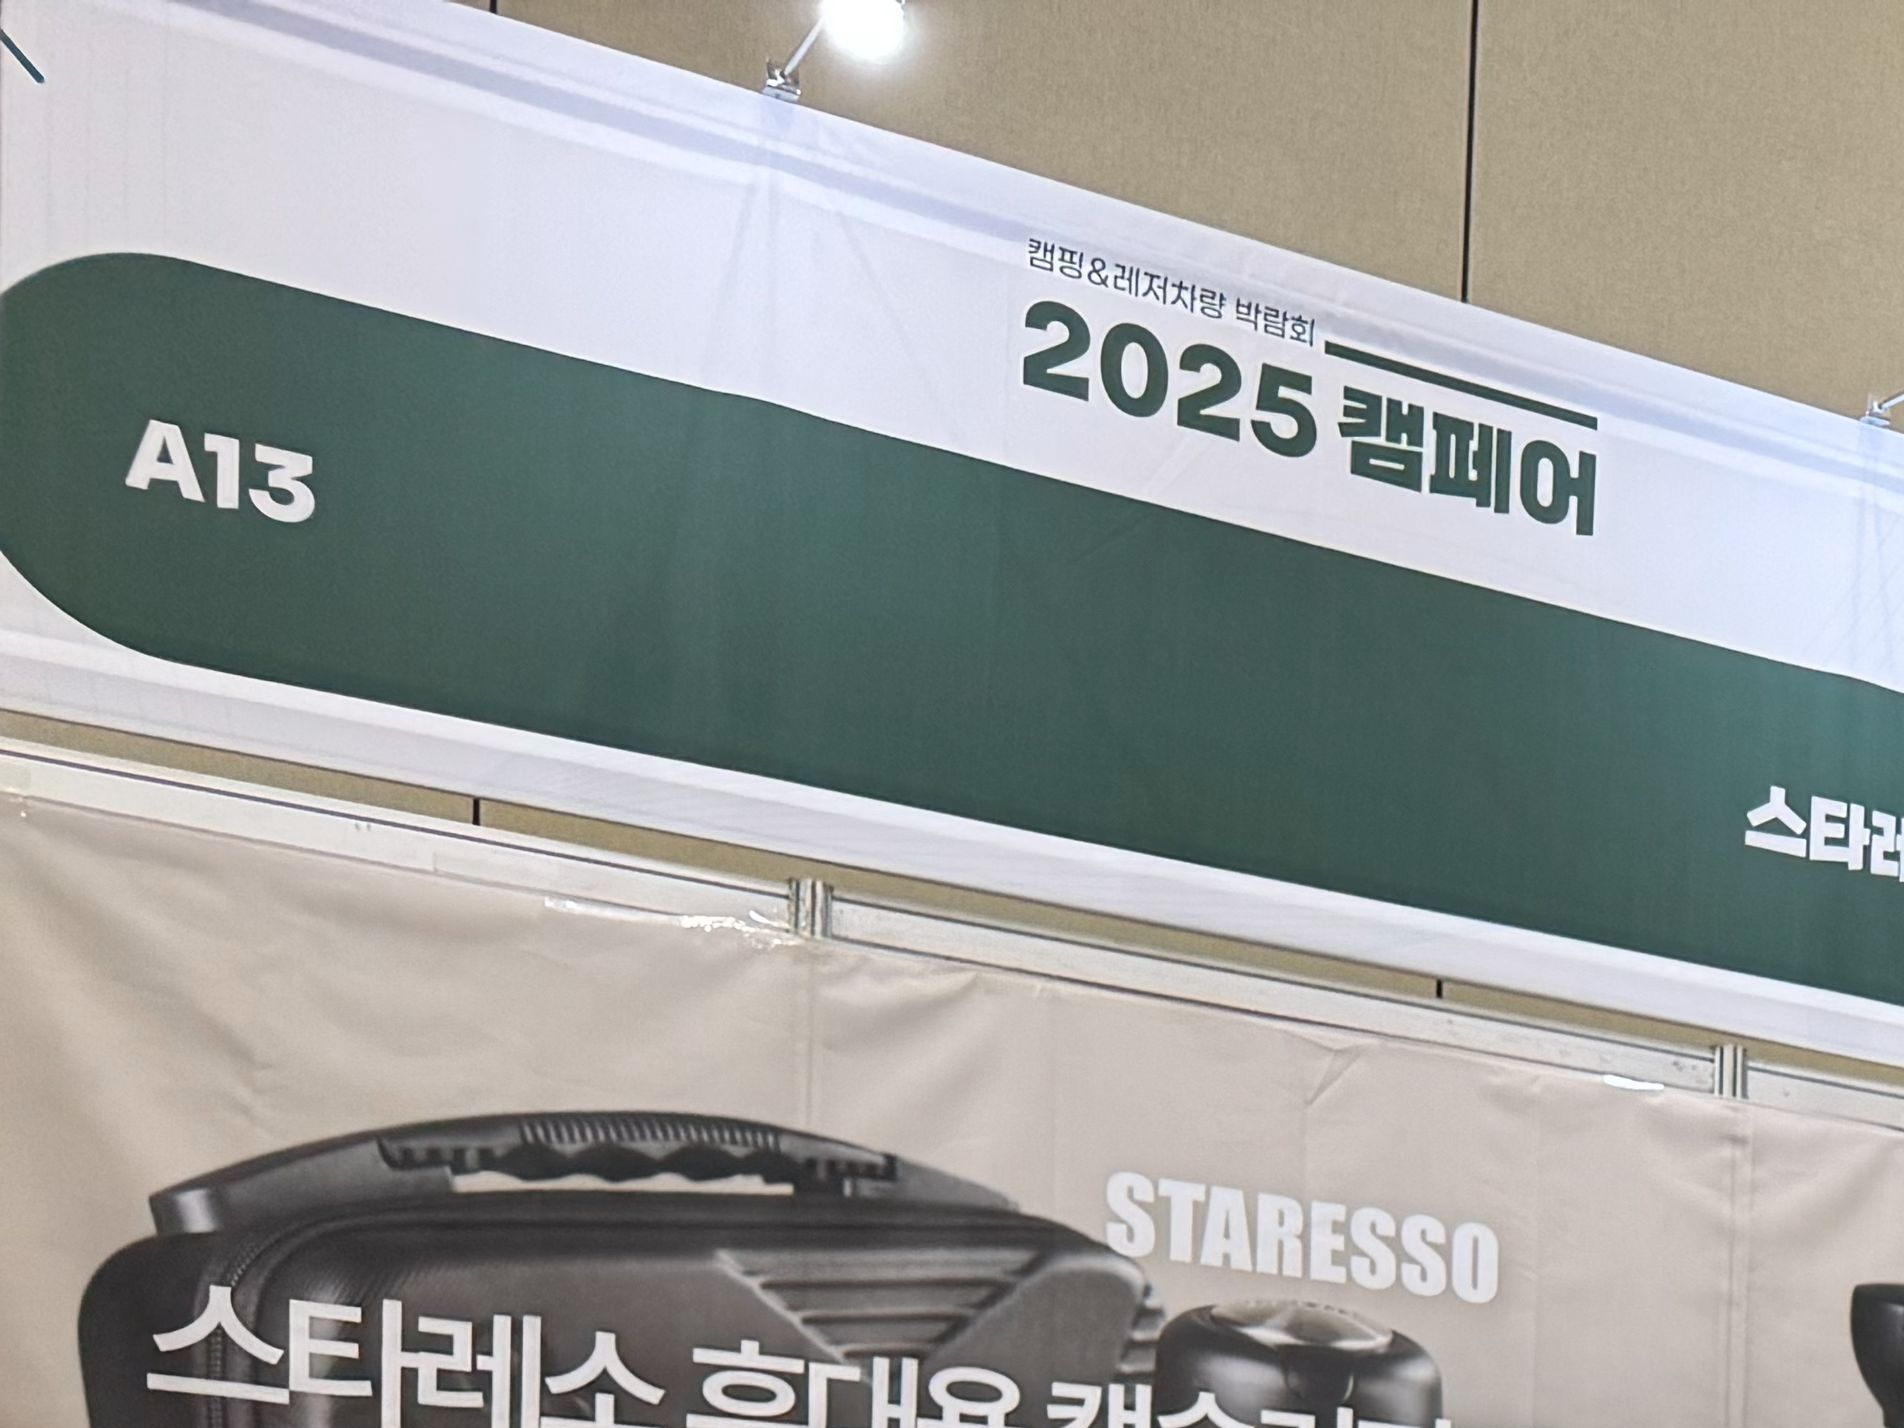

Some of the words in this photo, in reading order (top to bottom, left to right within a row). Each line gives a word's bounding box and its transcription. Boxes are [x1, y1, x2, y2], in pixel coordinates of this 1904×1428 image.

[1028, 238, 1227, 319] 캠핑&레저차량
[1235, 297, 1315, 347] 박람회
[124, 418, 317, 524] A13
[1023, 301, 1319, 459] 2025
[1337, 384, 1601, 538] 캠페어
[1103, 1171, 1502, 1304] STARESSO
